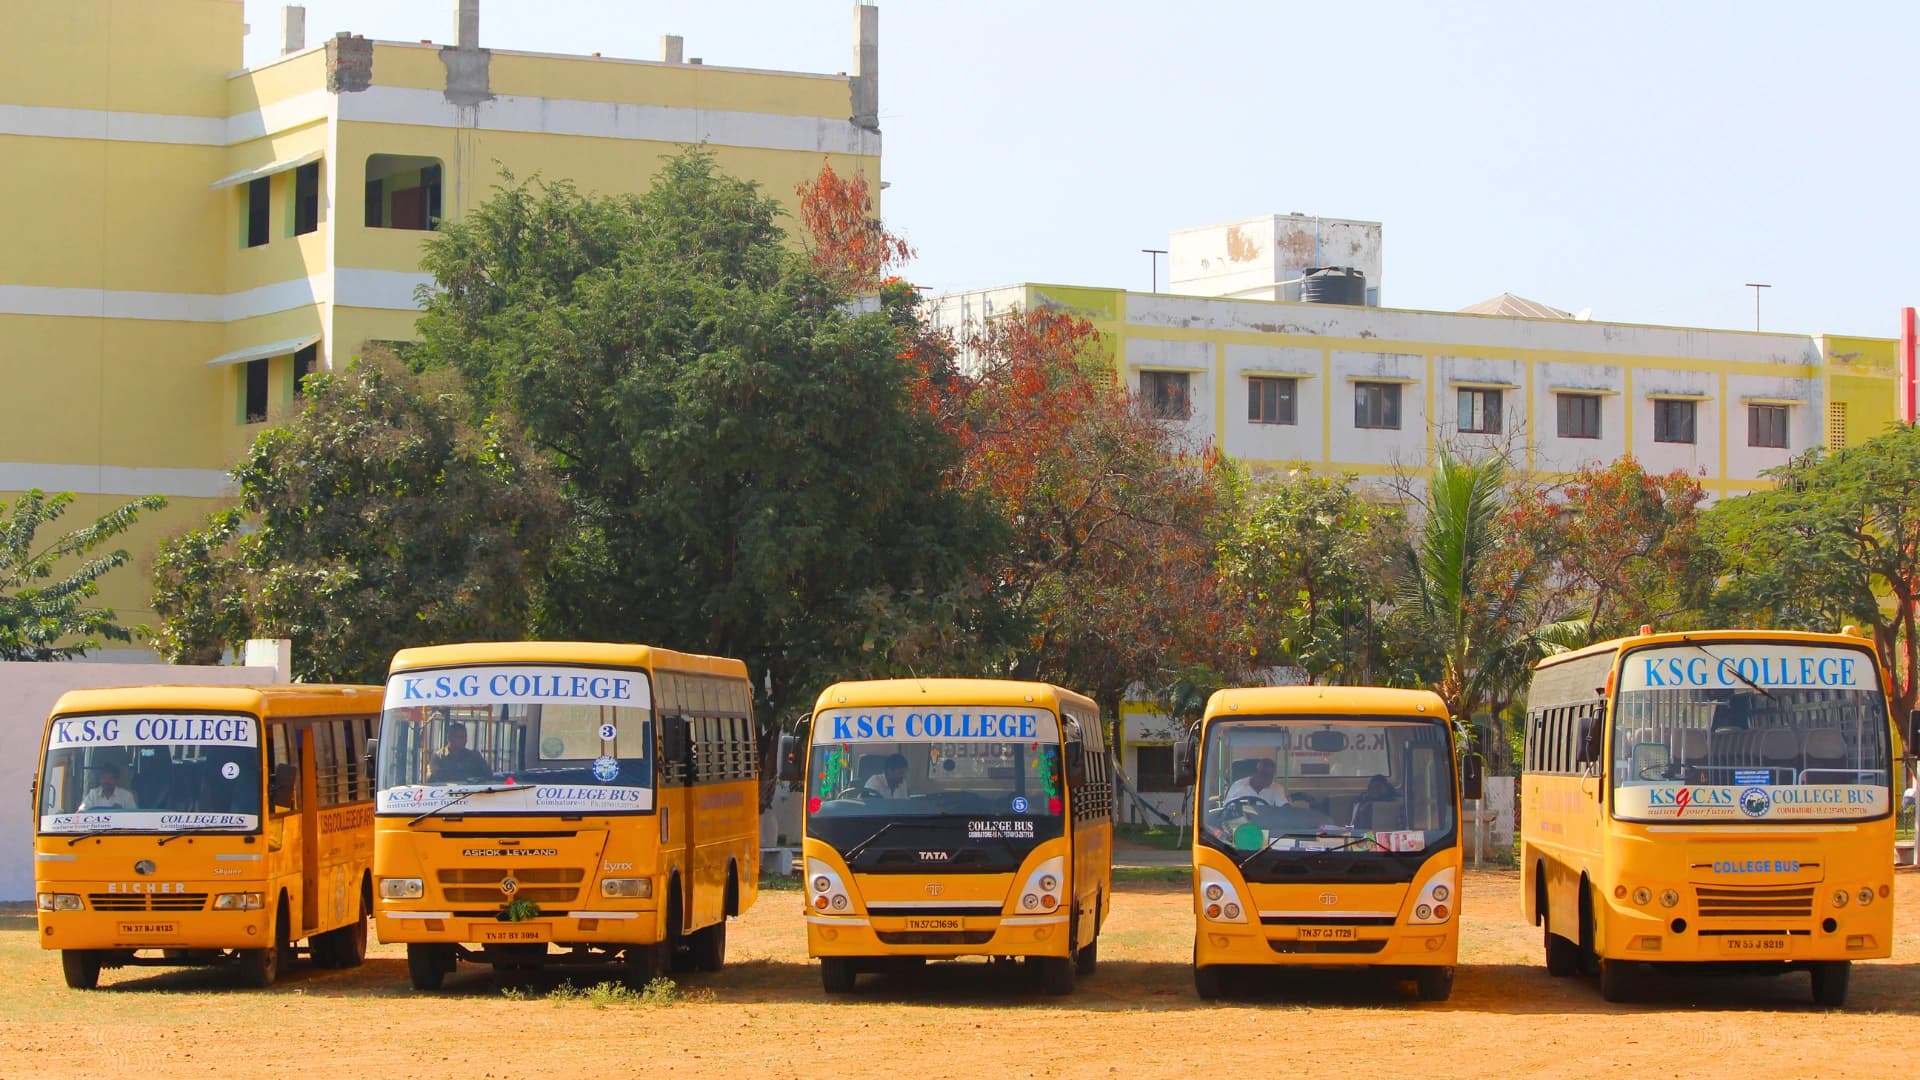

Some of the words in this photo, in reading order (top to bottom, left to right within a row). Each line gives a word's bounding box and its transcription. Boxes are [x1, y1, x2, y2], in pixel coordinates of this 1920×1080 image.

[1644, 657, 1708, 687] KSG
[1717, 657, 1857, 686] COLLEGE
[403, 675, 480, 700] K.S.G
[489, 674, 631, 700] COLLEGE
[58, 719, 120, 743] K.S.G
[135, 718, 249, 742] COLLEGE
[602, 725, 614, 737] 3
[832, 714, 895, 739] KSG
[905, 713, 1037, 739] COLLEGE
[536, 787, 608, 800] COLLEGE
[609, 790, 640, 802] BUS
[1772, 789, 1843, 804] COLLEGE
[1848, 789, 1874, 804] BUS
[1015, 799, 1025, 810] 5
[161, 814, 219, 824] COLLEGE
[220, 815, 246, 825] BUS
[968, 820, 1012, 831] COLLEGE
[1014, 820, 1034, 831] BUS
[918, 851, 948, 860] TATA
[603, 859, 633, 873] Lynx
[1714, 860, 1771, 873] COLLEGE
[1774, 860, 1800, 873] BUS
[108, 883, 185, 893] EICHER
[1728, 939, 1741, 949] TN
